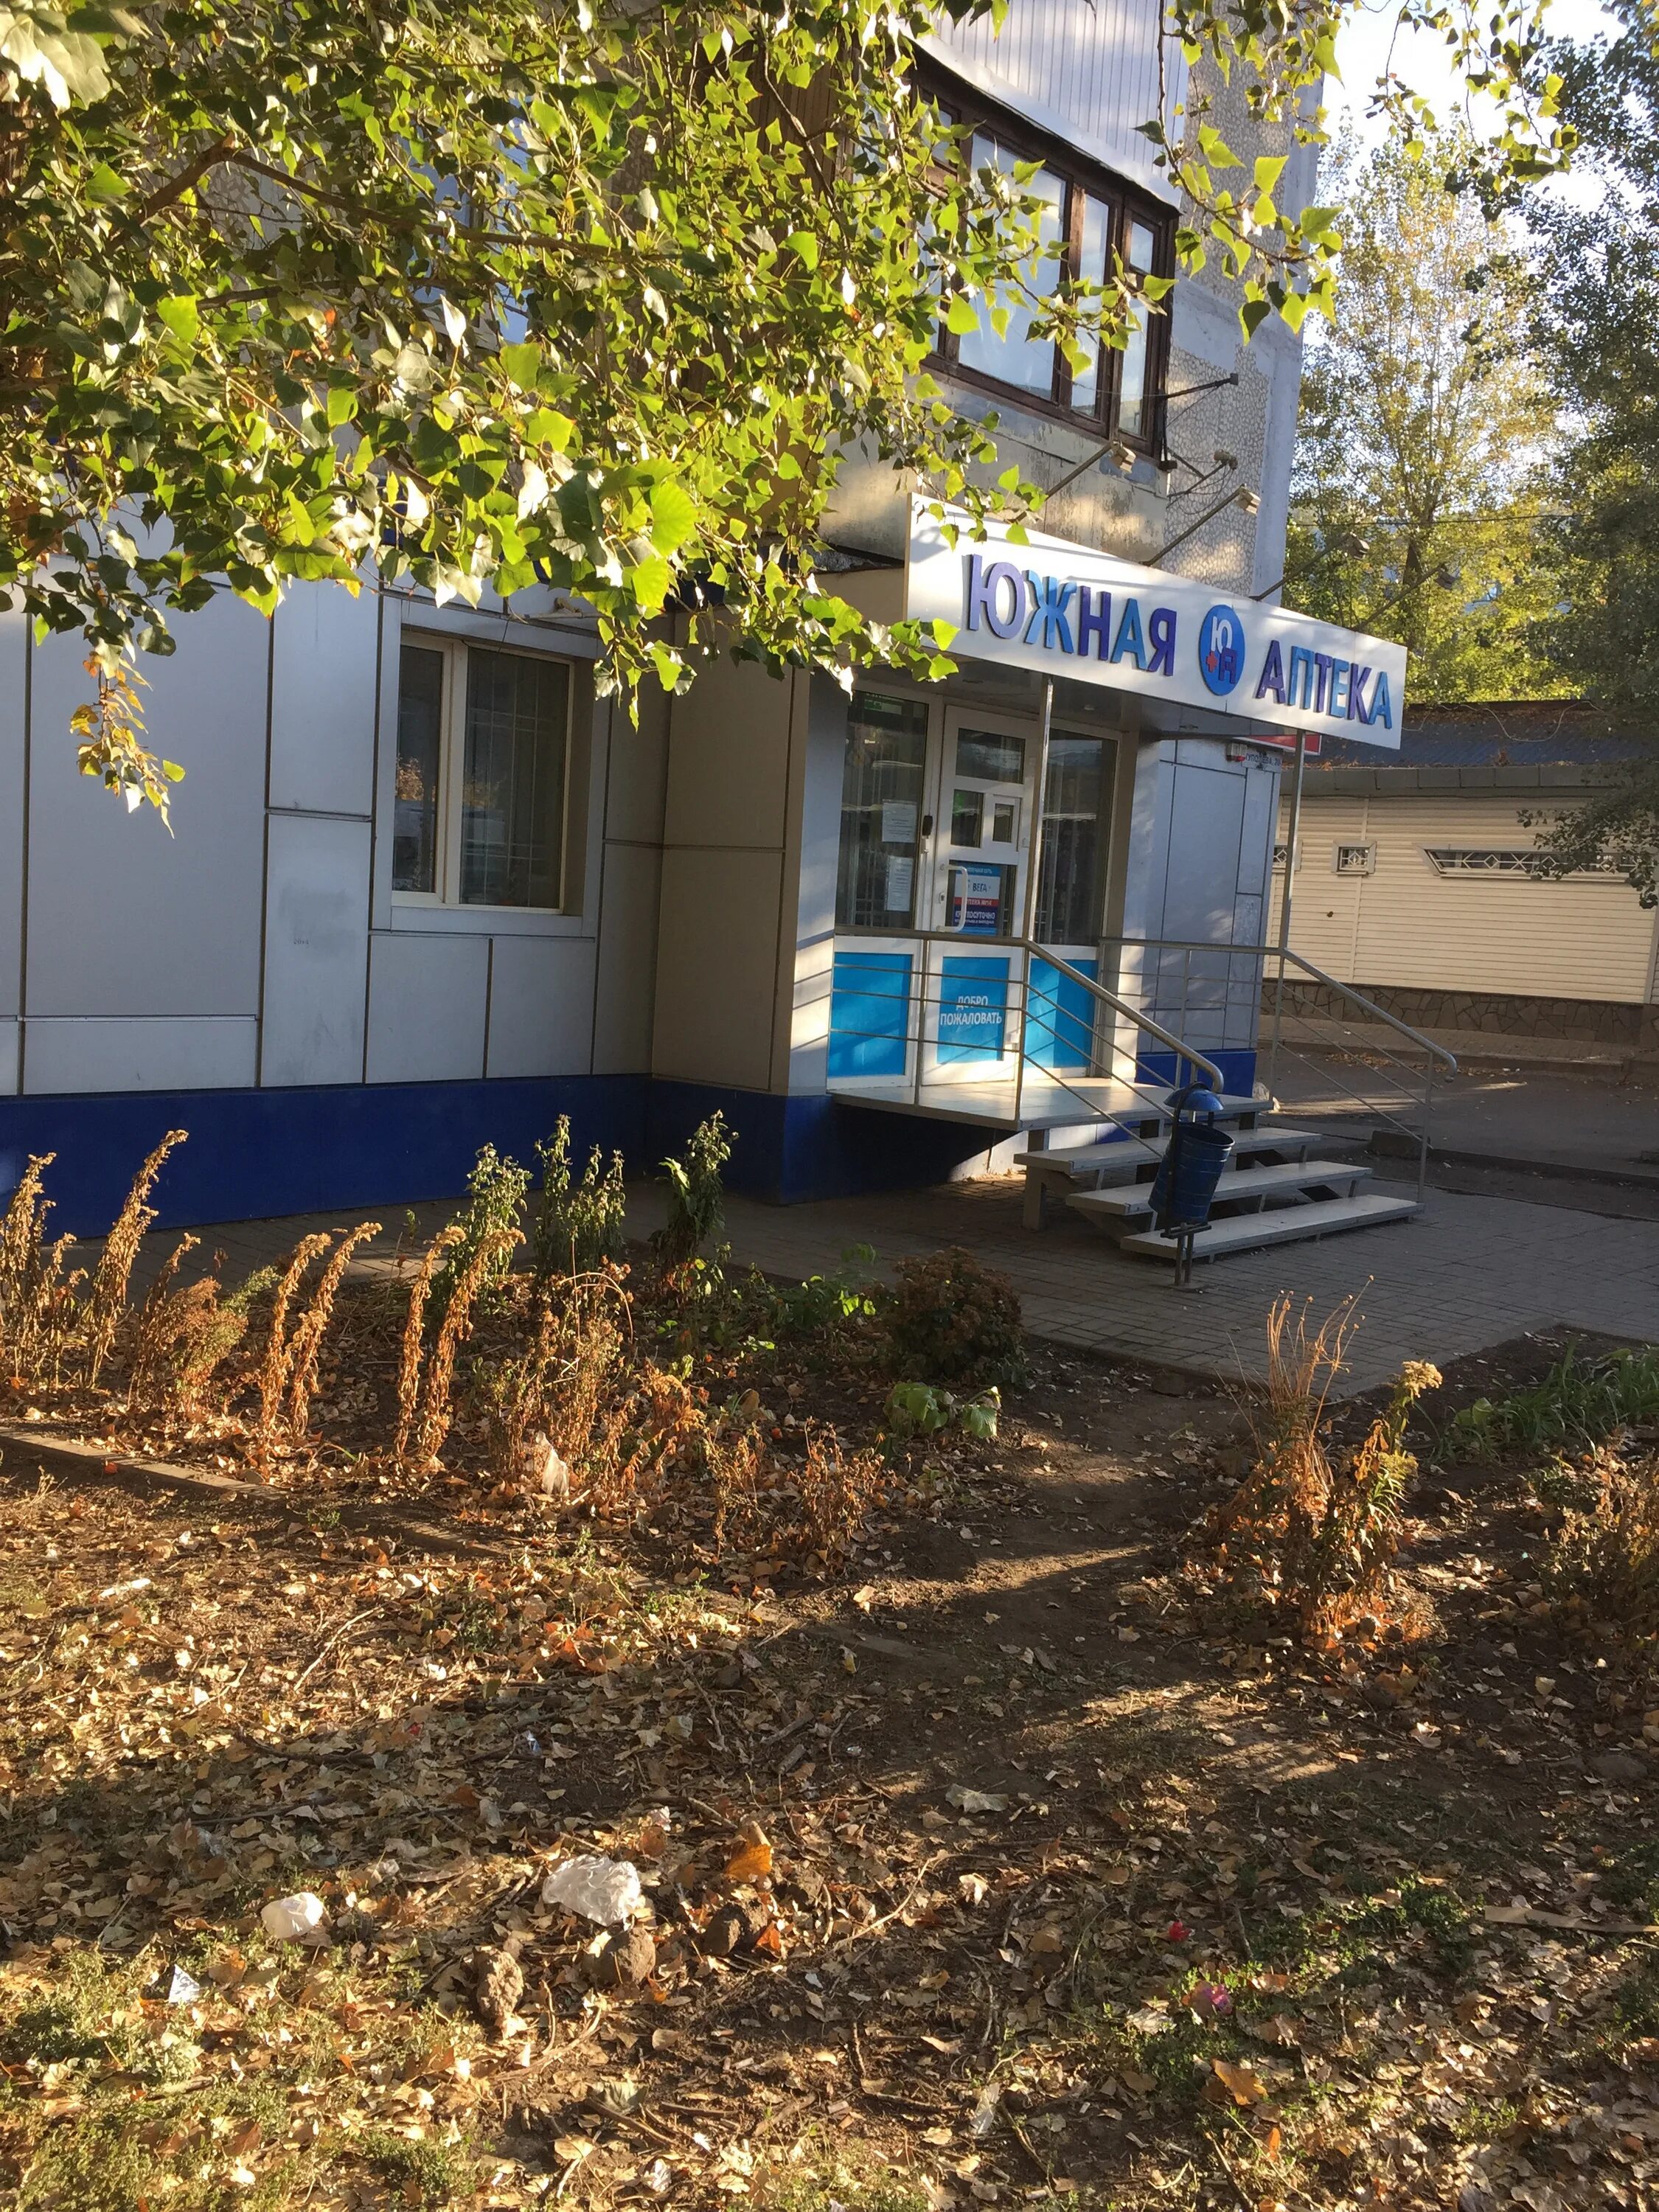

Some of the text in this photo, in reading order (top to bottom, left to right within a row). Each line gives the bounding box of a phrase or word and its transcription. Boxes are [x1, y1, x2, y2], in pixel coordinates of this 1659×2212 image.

[969, 554, 1393, 730] ЮЖНАЯ АПТЕКА
[973, 883, 987, 893] ВЕГА
[956, 995, 989, 1011] ДОБРО
[940, 1012, 1003, 1026] ПОЖАЛОВАТЬ
